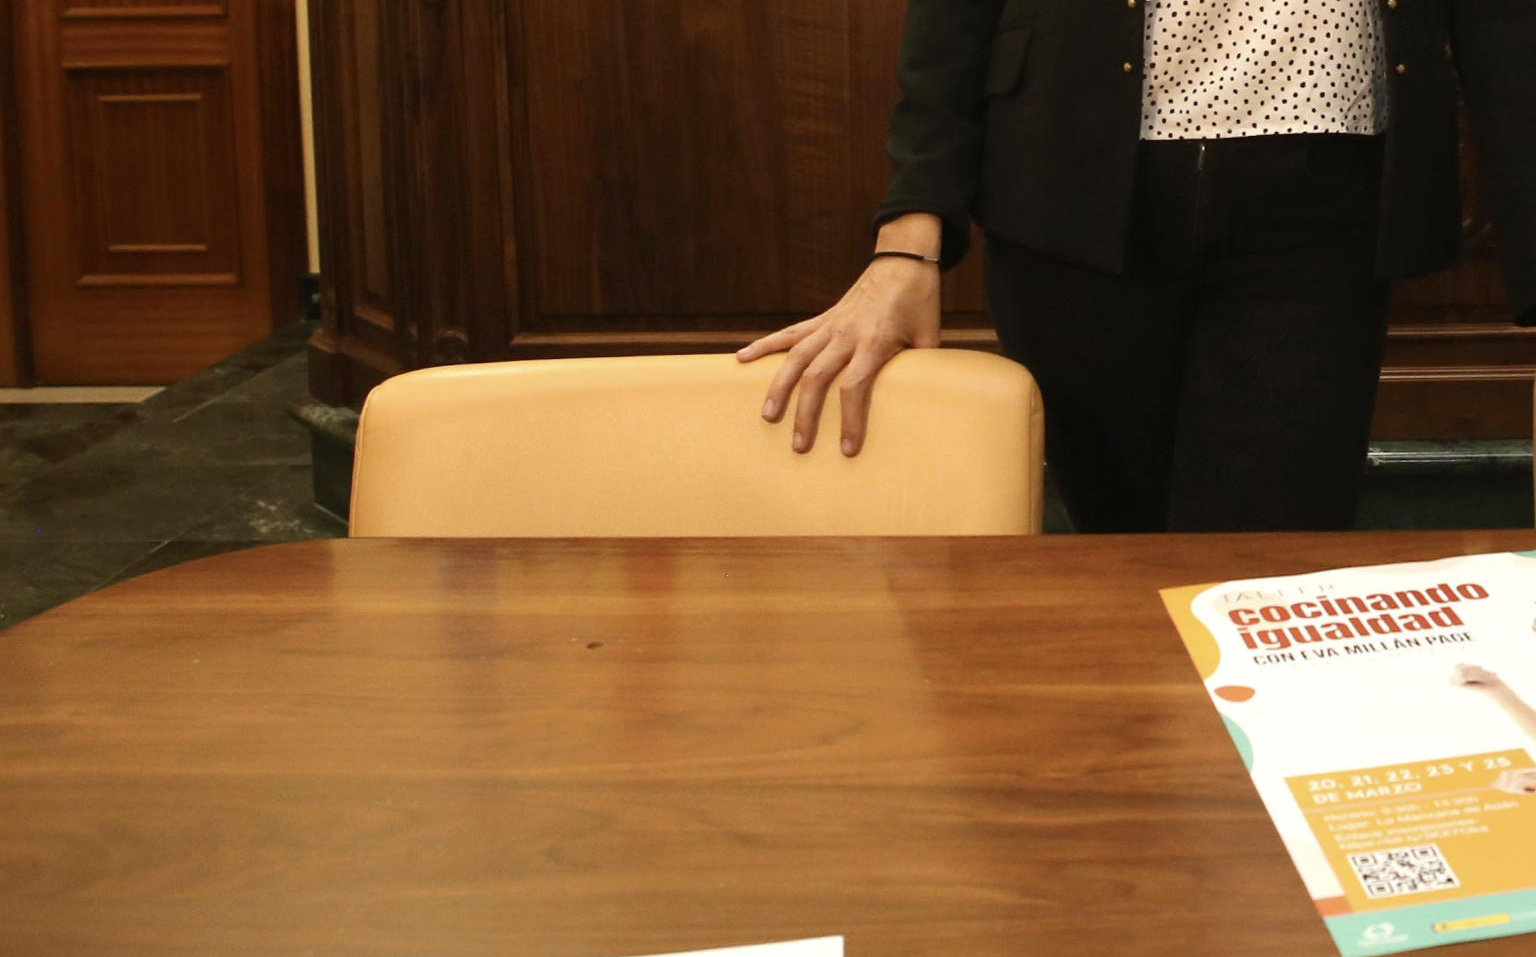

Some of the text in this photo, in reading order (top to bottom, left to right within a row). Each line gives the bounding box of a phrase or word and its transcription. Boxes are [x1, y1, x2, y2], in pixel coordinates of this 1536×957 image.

[1228, 583, 1489, 626] cocinando
[1237, 606, 1465, 650] igualdad
[1253, 651, 1295, 665] CON
[1300, 648, 1340, 661] EVA
[1344, 637, 1421, 655] MILLÁN
[1425, 631, 1479, 646] PAGE
[1426, 763, 1455, 778] 23
[1459, 760, 1474, 773] Y
[1483, 755, 1512, 770] 25
[1313, 781, 1422, 804] DE MARZO
